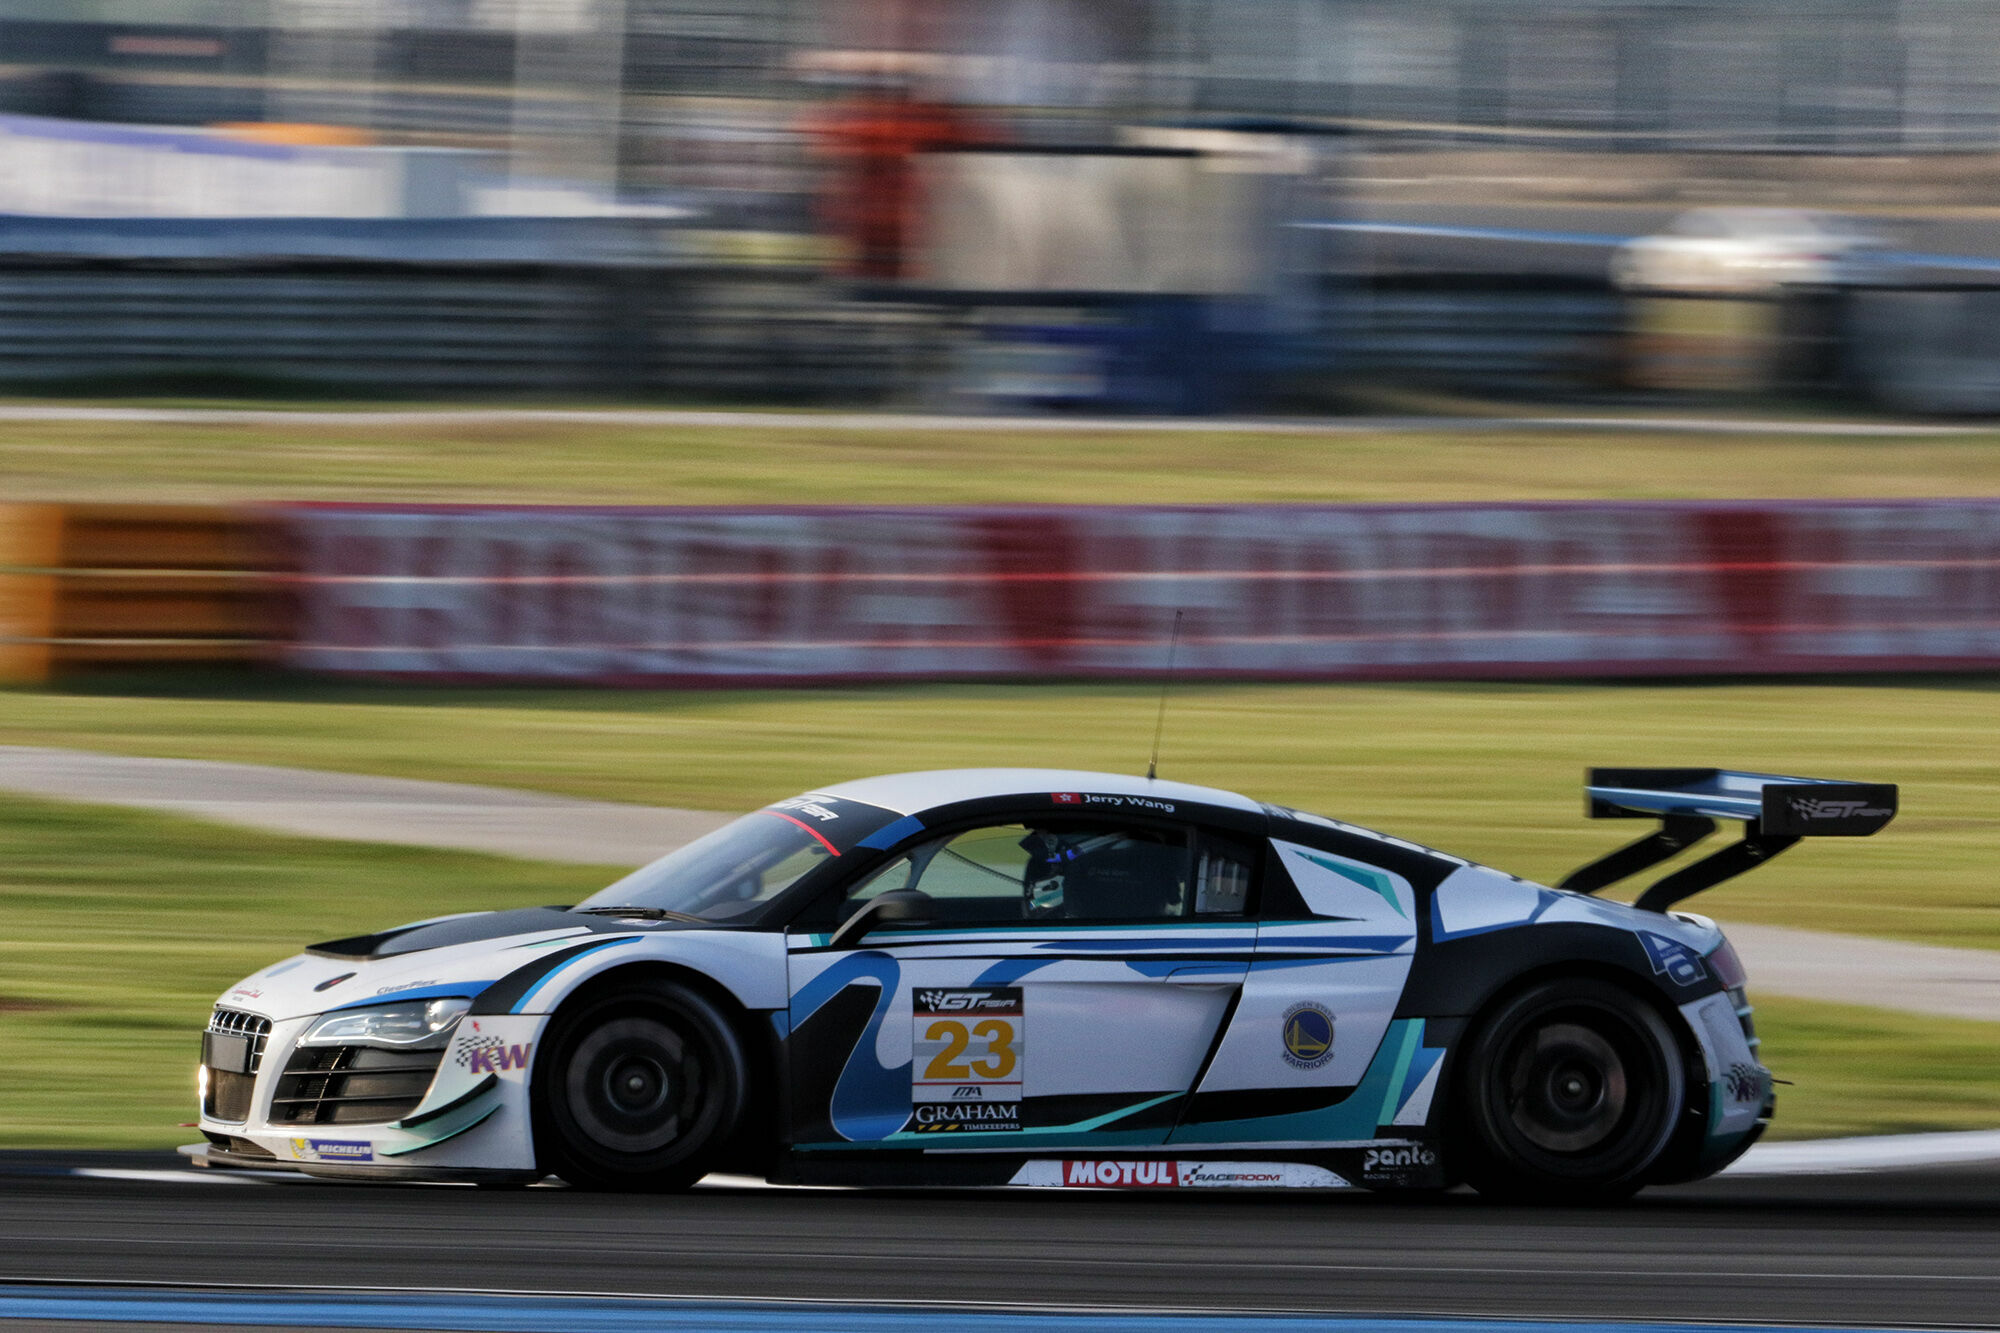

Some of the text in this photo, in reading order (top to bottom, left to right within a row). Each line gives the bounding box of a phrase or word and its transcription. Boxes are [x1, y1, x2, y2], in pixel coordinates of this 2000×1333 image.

[1084, 793, 1176, 813] Jerry Wang
[1811, 801, 1868, 818] GT
[938, 992, 992, 1010] GT
[471, 1043, 532, 1075] KW
[923, 1020, 1016, 1079] 23
[1281, 1050, 1334, 1070] WARRIORS
[915, 1104, 1018, 1123] GRAHAM
[963, 1123, 1020, 1131] TIMEKEEPERS
[318, 1144, 371, 1155] MICHELIN
[1068, 1161, 1173, 1184] MOTUL
[1195, 1173, 1281, 1182] RACEROOM
